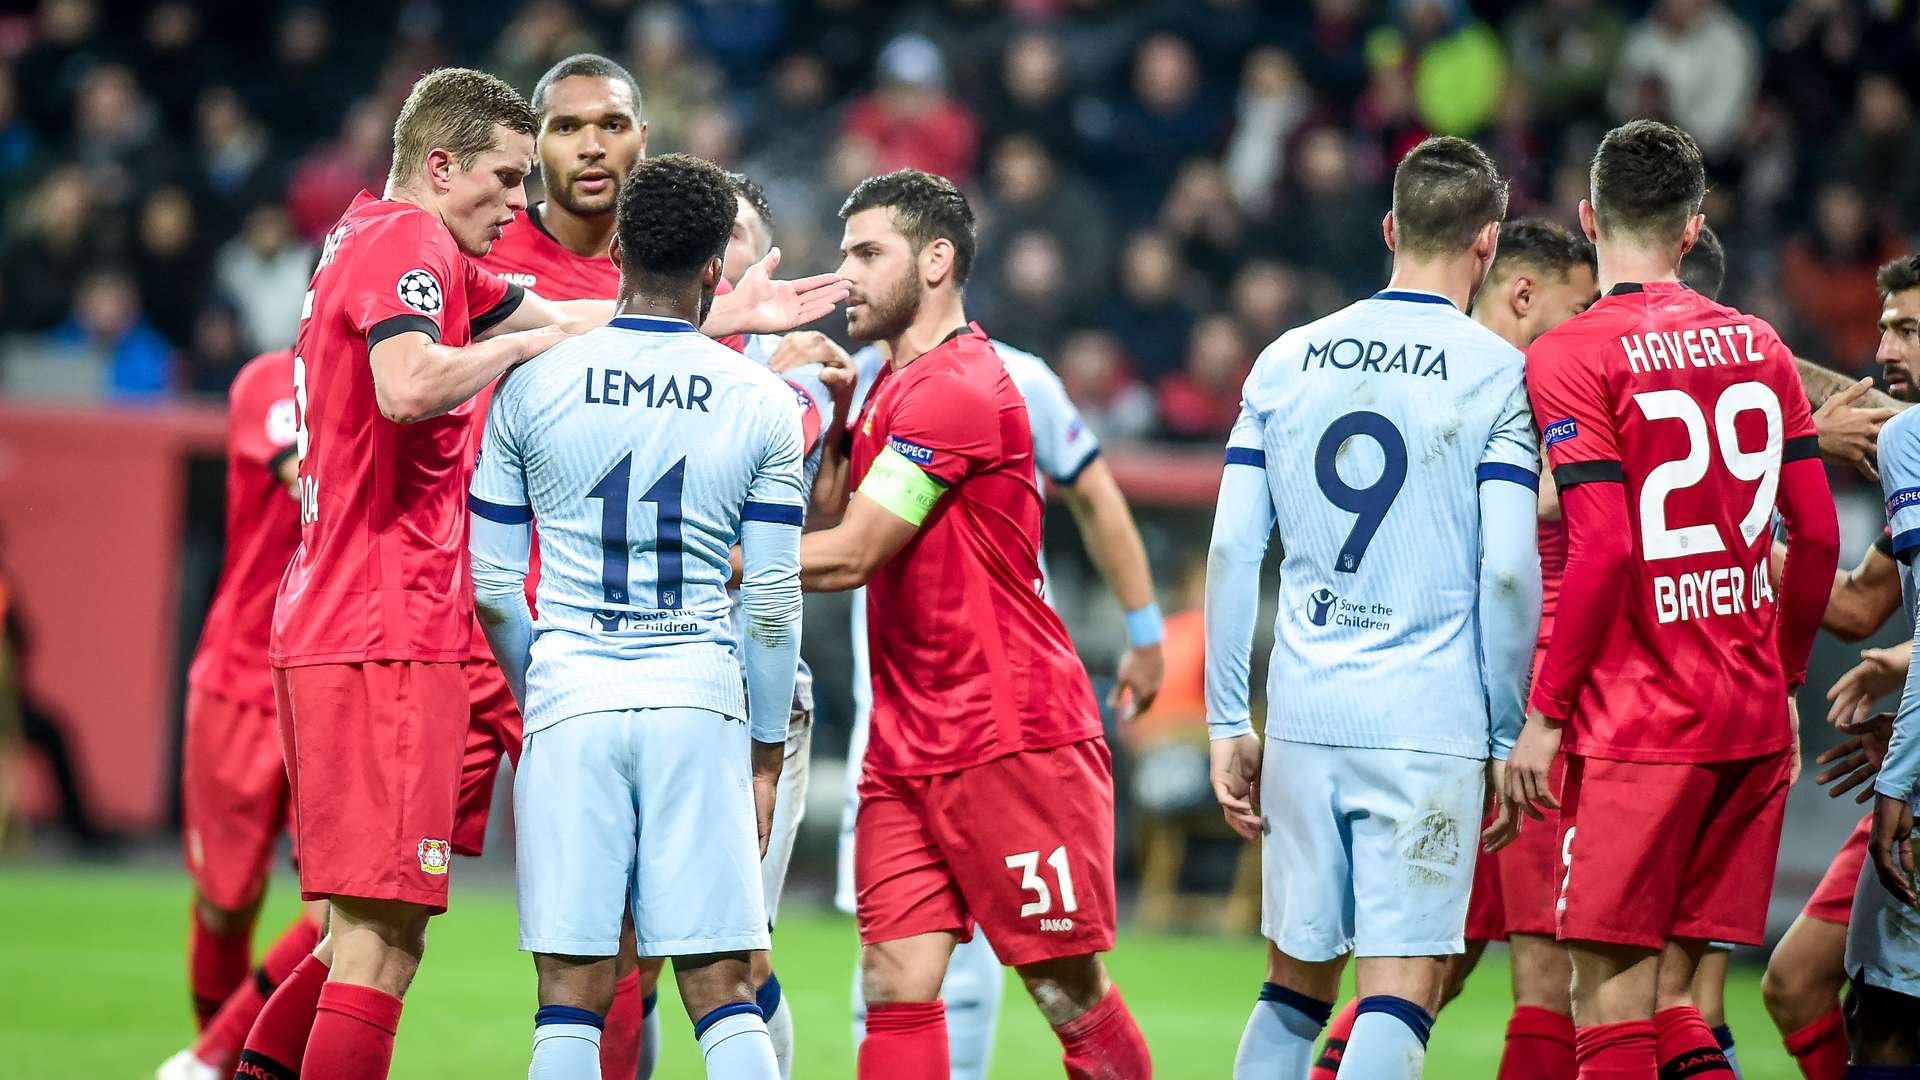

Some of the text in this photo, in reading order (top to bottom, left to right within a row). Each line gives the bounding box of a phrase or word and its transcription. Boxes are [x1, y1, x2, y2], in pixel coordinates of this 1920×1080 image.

[1302, 338, 1448, 381] MORATA
[1621, 325, 1764, 373] HAVERTZ
[585, 367, 713, 412] LEMAR
[892, 440, 933, 460] RESPECT
[1545, 422, 1575, 442] SPECT
[1314, 411, 1409, 574] 9
[1632, 381, 1783, 561] 29
[585, 450, 687, 610] 11
[1340, 599, 1393, 616] Save the
[1654, 557, 1774, 624] BAYER 04
[632, 610, 668, 621] Save
[634, 622, 698, 633] Children
[1336, 613, 1390, 631] Children
[1005, 845, 1078, 918] 31
[1040, 918, 1073, 932] JAKO
